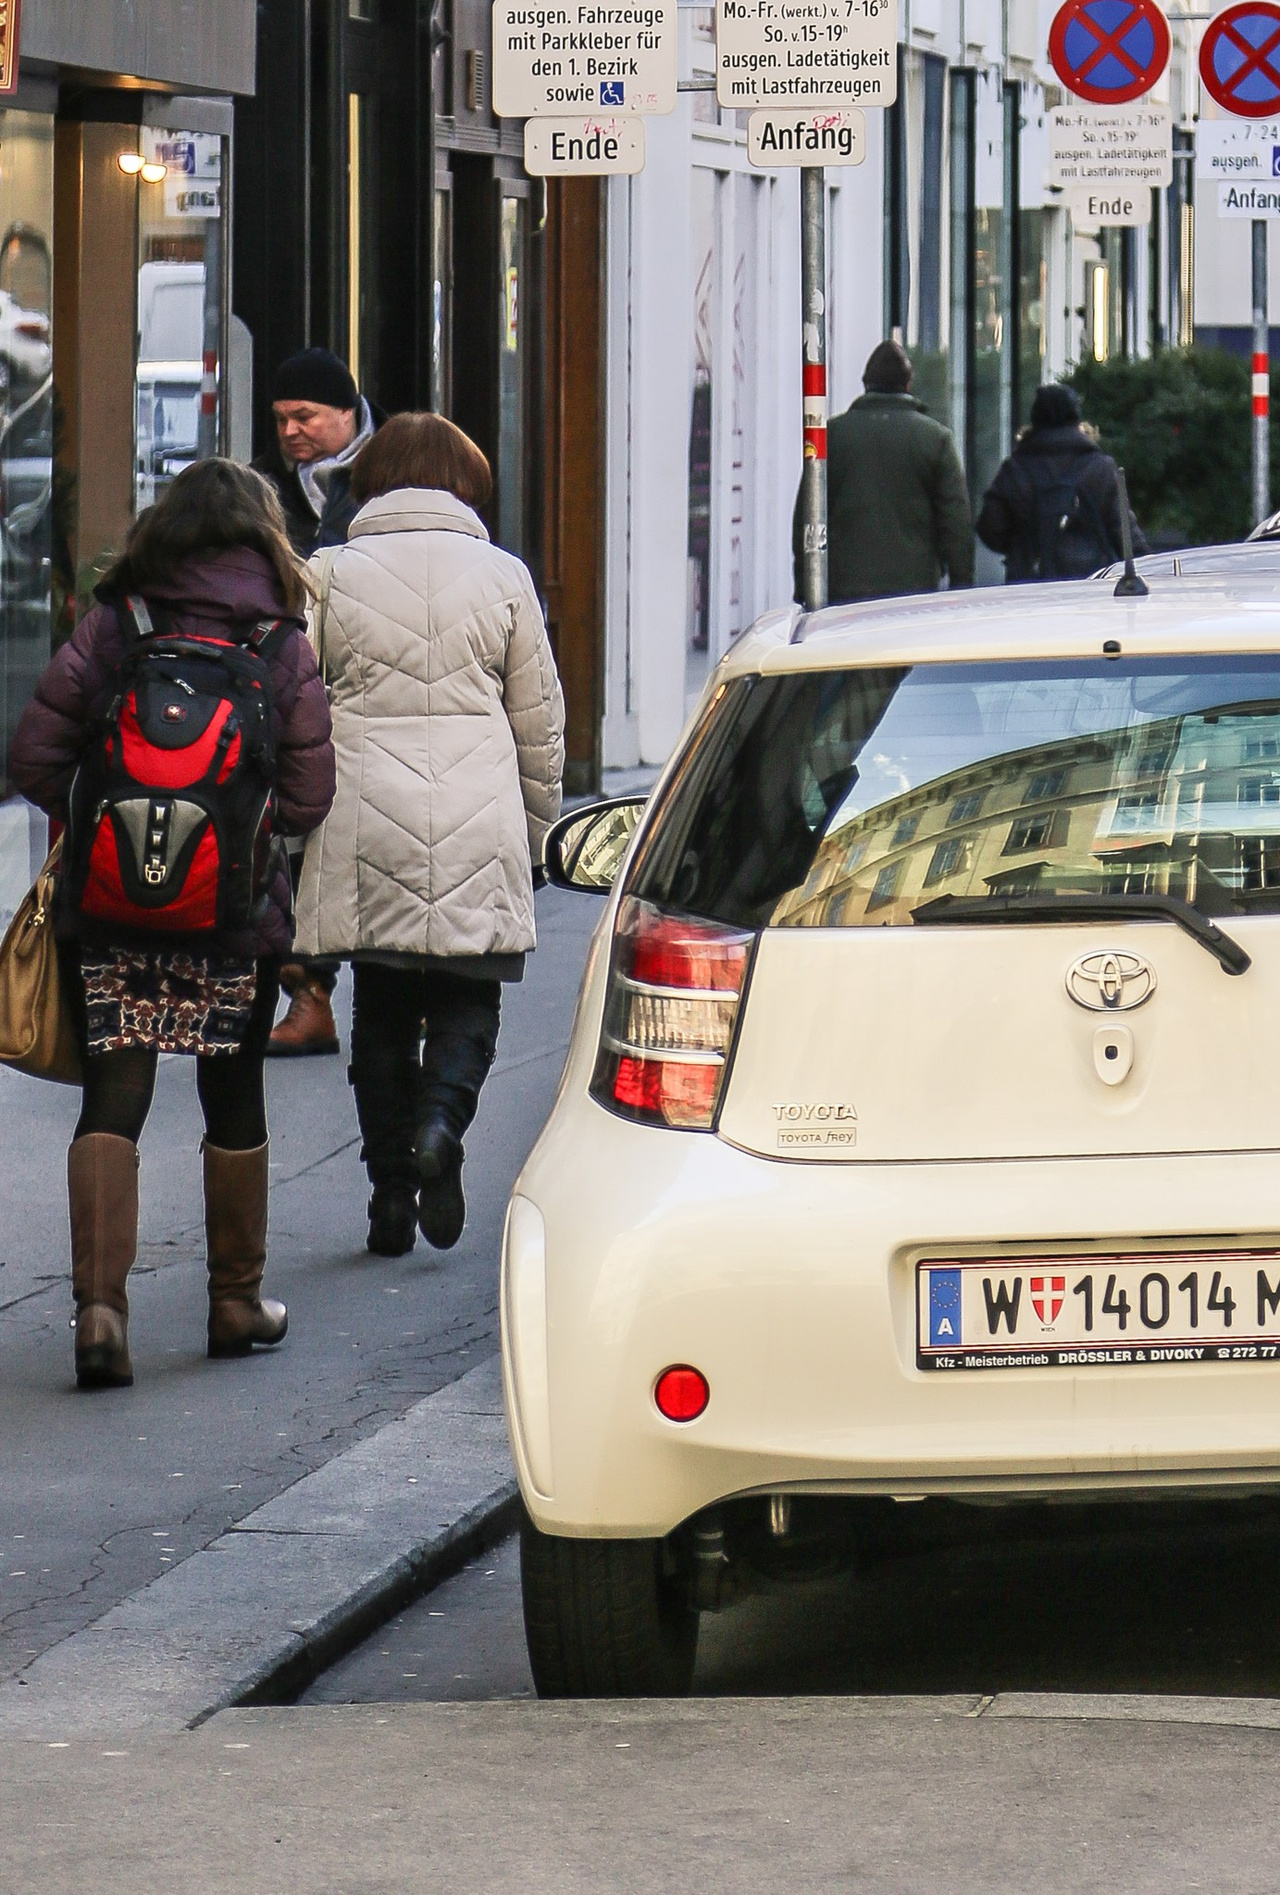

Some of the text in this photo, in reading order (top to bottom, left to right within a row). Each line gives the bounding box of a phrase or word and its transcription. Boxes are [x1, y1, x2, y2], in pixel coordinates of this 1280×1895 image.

[506, 6, 664, 28] ausgen. Fahrzeuge
[724, 0, 779, 19] Mo.-Fr.
[781, 3, 827, 20] (werkt.)
[830, 7, 840, 18] v.
[508, 31, 662, 50] mit Parkkleber für
[764, 25, 788, 43] So.
[531, 56, 638, 76] den 1. Bezirk
[722, 48, 890, 71] ausgen. Ladetätigkeit
[546, 83, 595, 102] sowie
[731, 76, 881, 97] mit Lastfahrzeugen
[552, 131, 619, 161] Ende
[760, 122, 853, 155] Anfang
[1060, 165, 1077, 177] mit
[1211, 155, 1262, 171] ausgen.
[1088, 195, 1134, 216] Ende
[771, 1103, 859, 1121] TOYOTA
[780, 1133, 822, 1143] TOYOTA
[982, 1276, 1023, 1335] W
[1072, 1269, 1237, 1332] 14014
[937, 1317, 955, 1336] A
[935, 1356, 956, 1369] Kfz
[965, 1353, 1049, 1368] Meisterbetrieb
[1058, 1348, 1132, 1364] DRÖSSLER
[1135, 1350, 1147, 1361] &
[1150, 1348, 1205, 1361] DIVOKY
[1232, 1346, 1259, 1358] 272
[1261, 1346, 1277, 1358] 77
